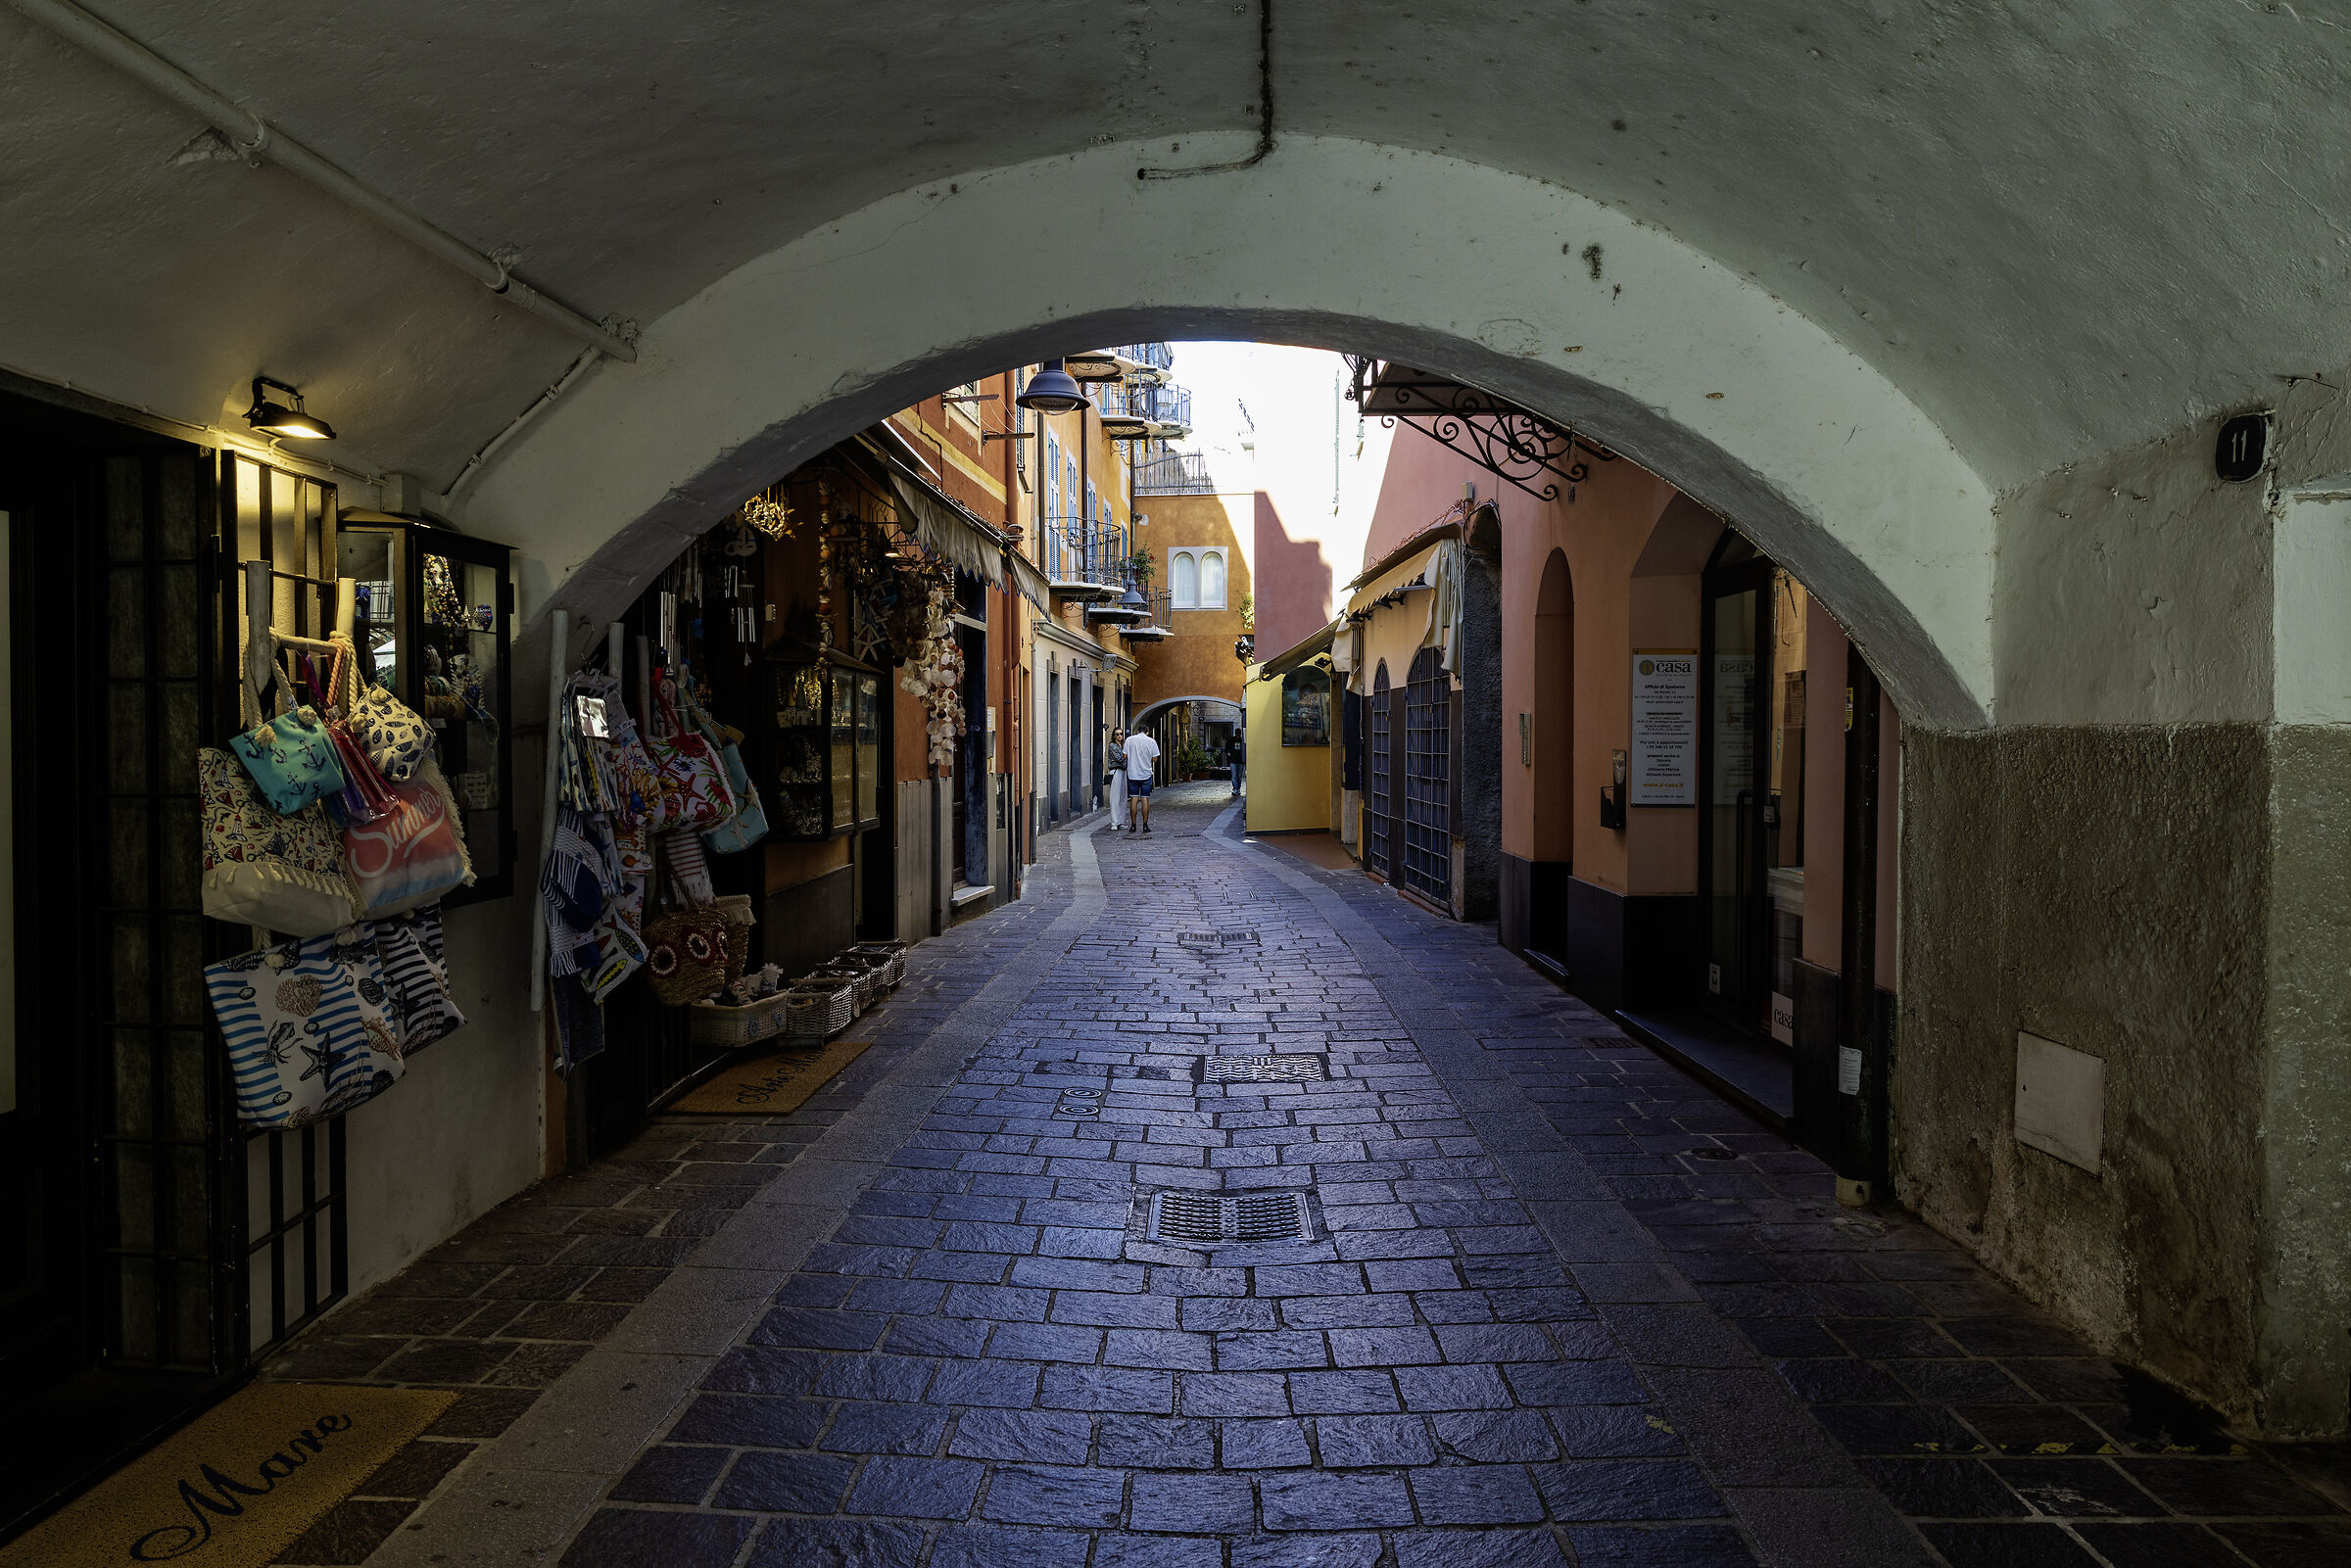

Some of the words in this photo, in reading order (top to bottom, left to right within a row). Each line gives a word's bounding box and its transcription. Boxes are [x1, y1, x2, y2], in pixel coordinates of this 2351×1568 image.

[2231, 429, 2247, 463] 11
[1655, 662, 1692, 674] casa
[349, 786, 446, 879] Summer
[1773, 1008, 1795, 1030] casa
[129, 1413, 353, 1562] Mare
